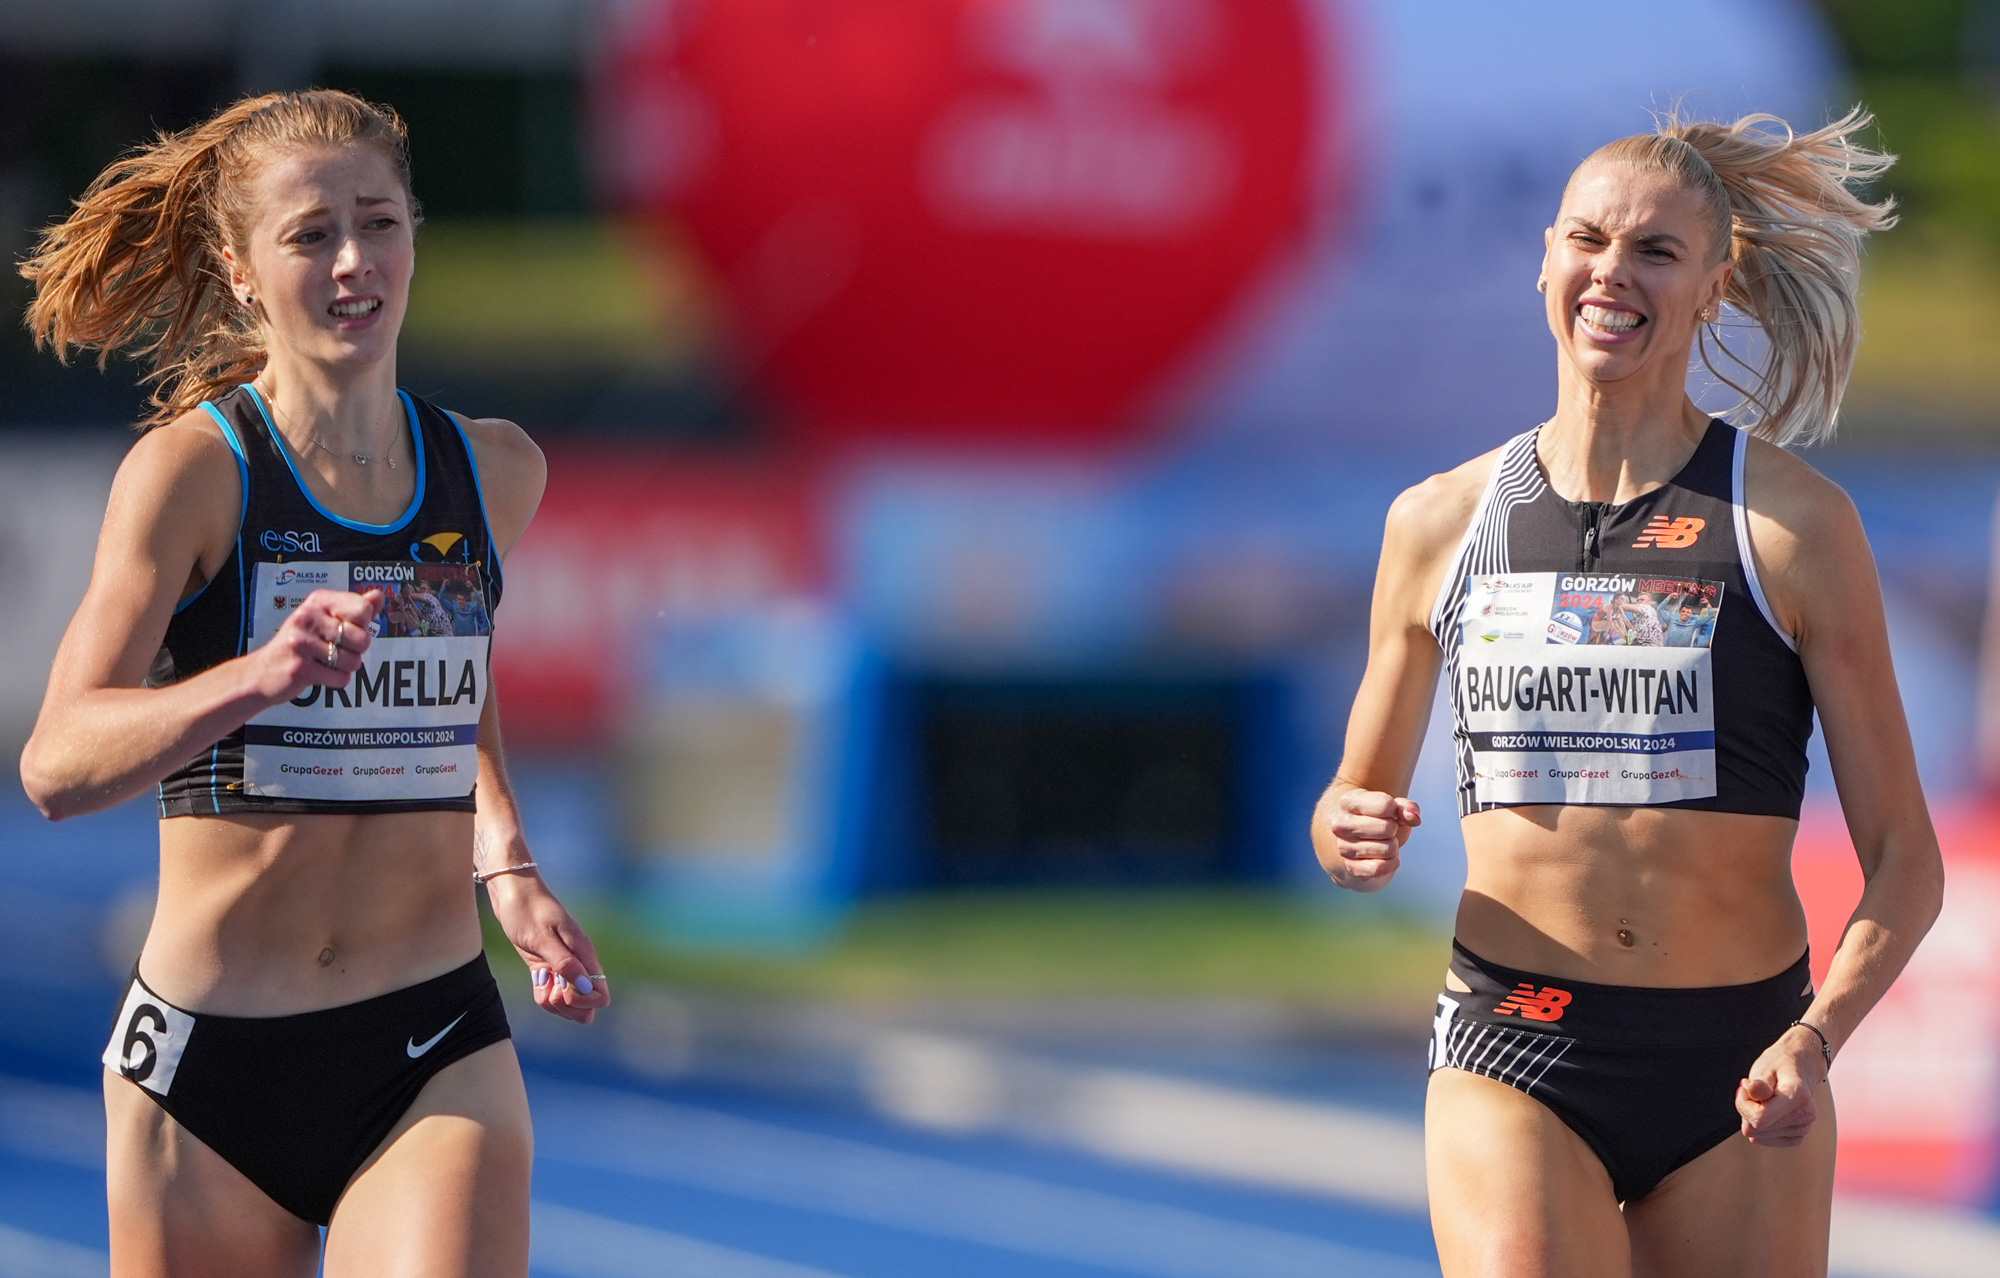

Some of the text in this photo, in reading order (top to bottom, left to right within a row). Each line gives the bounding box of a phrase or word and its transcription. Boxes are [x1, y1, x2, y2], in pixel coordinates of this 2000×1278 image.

[1632, 515, 1706, 549] NB
[353, 562, 414, 581] GORZÓW
[355, 584, 395, 600] 24
[1561, 575, 1717, 599] GORZÓW MEETING
[1559, 594, 1604, 609] 2024
[1466, 665, 1699, 715] BAUGART-WITAN
[283, 730, 455, 746] GORZÓW WIELKOPOLSKI 2024
[1492, 734, 1676, 751] GORZÓW WIELKOPOLSKI 2024
[280, 763, 457, 777] GrupaGezet GrupaGezet GrupaGezet
[1548, 768, 1610, 780] GrupaGezet
[1621, 767, 1680, 781] GrupaGezet
[1493, 983, 1573, 1022] NB
[119, 1003, 167, 1082] 6
